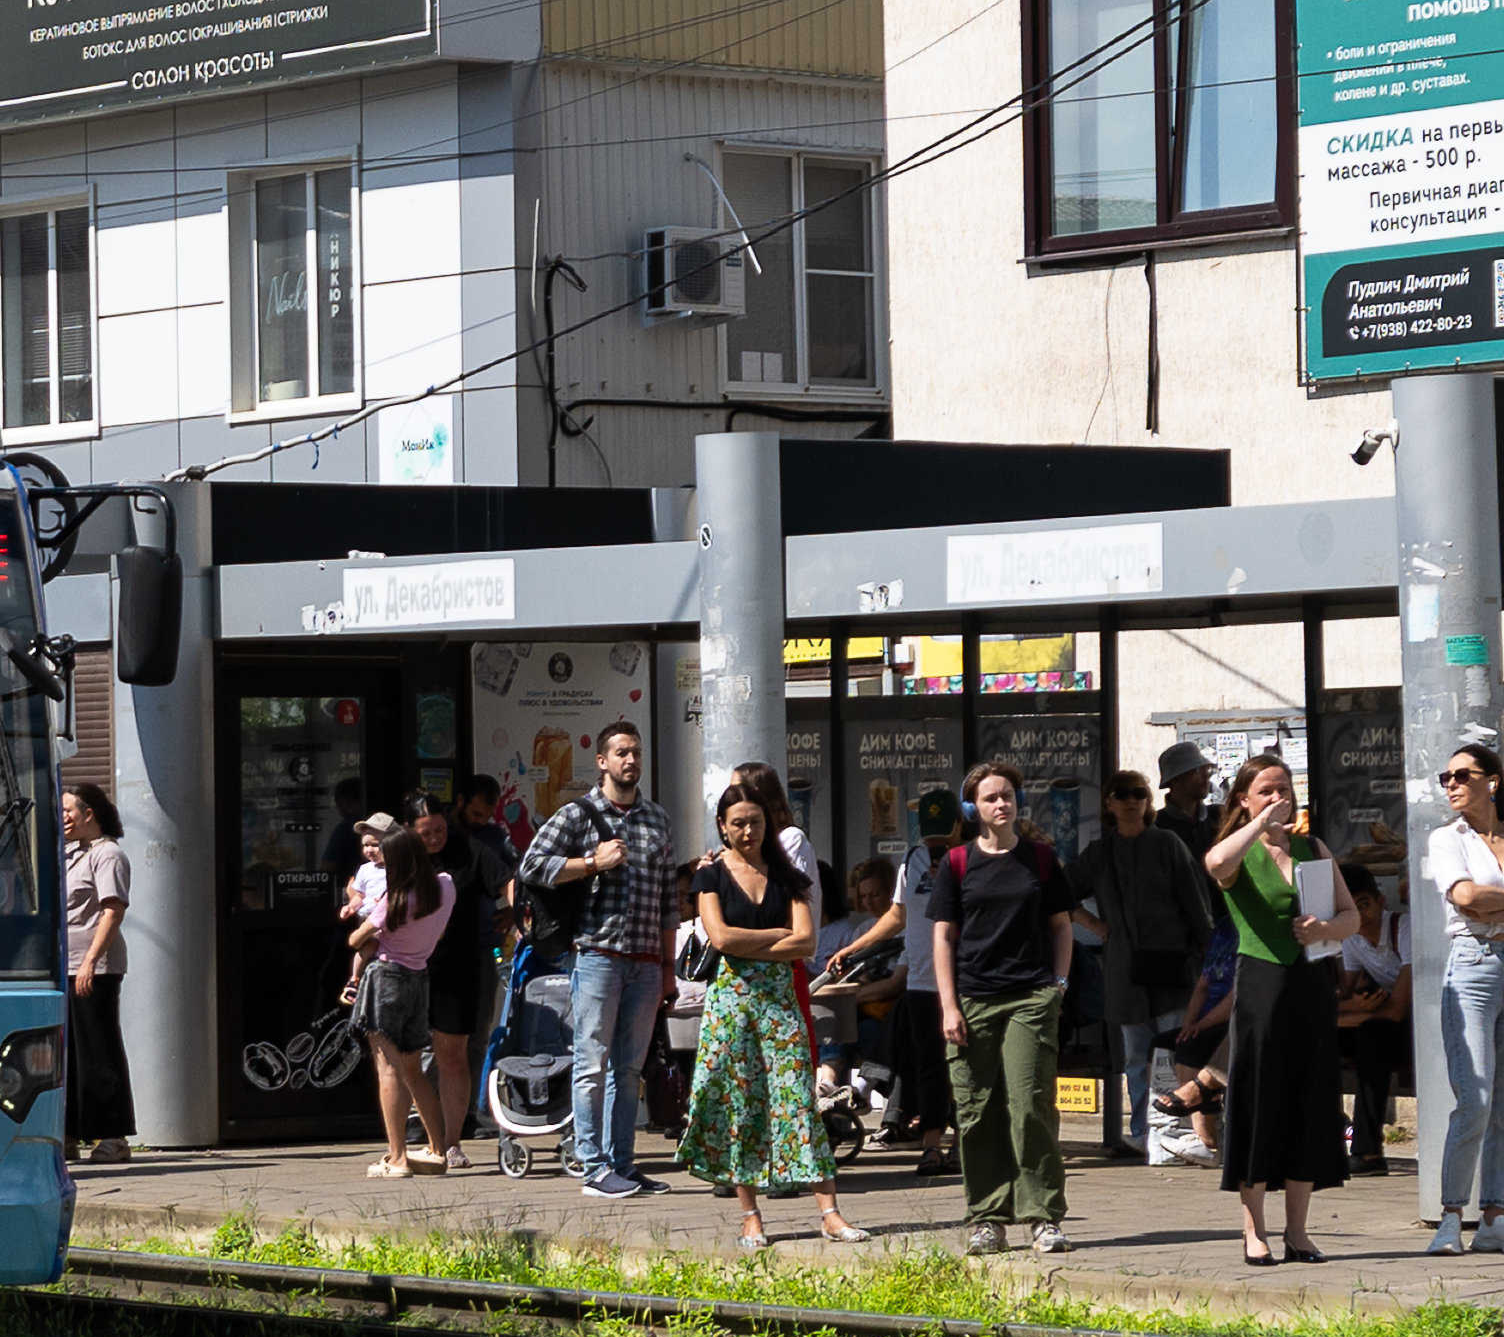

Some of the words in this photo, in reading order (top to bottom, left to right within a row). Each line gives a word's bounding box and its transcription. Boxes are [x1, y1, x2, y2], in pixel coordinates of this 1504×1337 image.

[30, 19, 99, 43] КЕРАТИНОВОЕ
[100, 5, 174, 31] ВЫПРЯМЛЕНИЕ
[82, 40, 124, 59] БОТОКС
[125, 37, 146, 55] ДЛЯ
[148, 30, 187, 49] ВОЛОС
[192, 15, 272, 41] ОКРАШИВАНИЯ
[278, 5, 328, 27] СТРИЖКИ
[1336, 44, 1364, 61] боли
[1366, 44, 1375, 55] и
[1378, 33, 1456, 55] ограничения
[132, 63, 190, 90] салон
[195, 49, 274, 83] красоты
[1380, 85, 1387, 96] и
[1412, 75, 1470, 93] суставах.
[1326, 127, 1414, 155] СКИДКА
[1422, 129, 1443, 143] на
[1328, 157, 1406, 182] массажа
[1426, 147, 1458, 169] 500
[1466, 149, 1481, 169] р.
[1370, 185, 1461, 211] Первичная
[1370, 207, 1487, 233] консультация
[328, 235, 340, 317] НИКЮР
[1348, 280, 1400, 301] Пудлич
[1404, 267, 1470, 293] Дмитрий
[1349, 296, 1442, 319] Анатольевич
[1362, 325, 1406, 339] +7(938)
[1410, 315, 1472, 333] 422-80-23
[354, 583, 378, 622] ул.
[385, 571, 504, 619] Декабристов
[860, 735, 890, 753] ДИМ
[896, 733, 935, 751] КОФЕ
[1011, 731, 1042, 749] ДИМ
[1048, 730, 1088, 747] КОФЕ
[1360, 728, 1395, 747] ДИМ
[860, 755, 917, 769] СНИЖАЕТ
[919, 753, 952, 769] ЦЕНЫ
[278, 873, 328, 883] ОТКРЫТО
